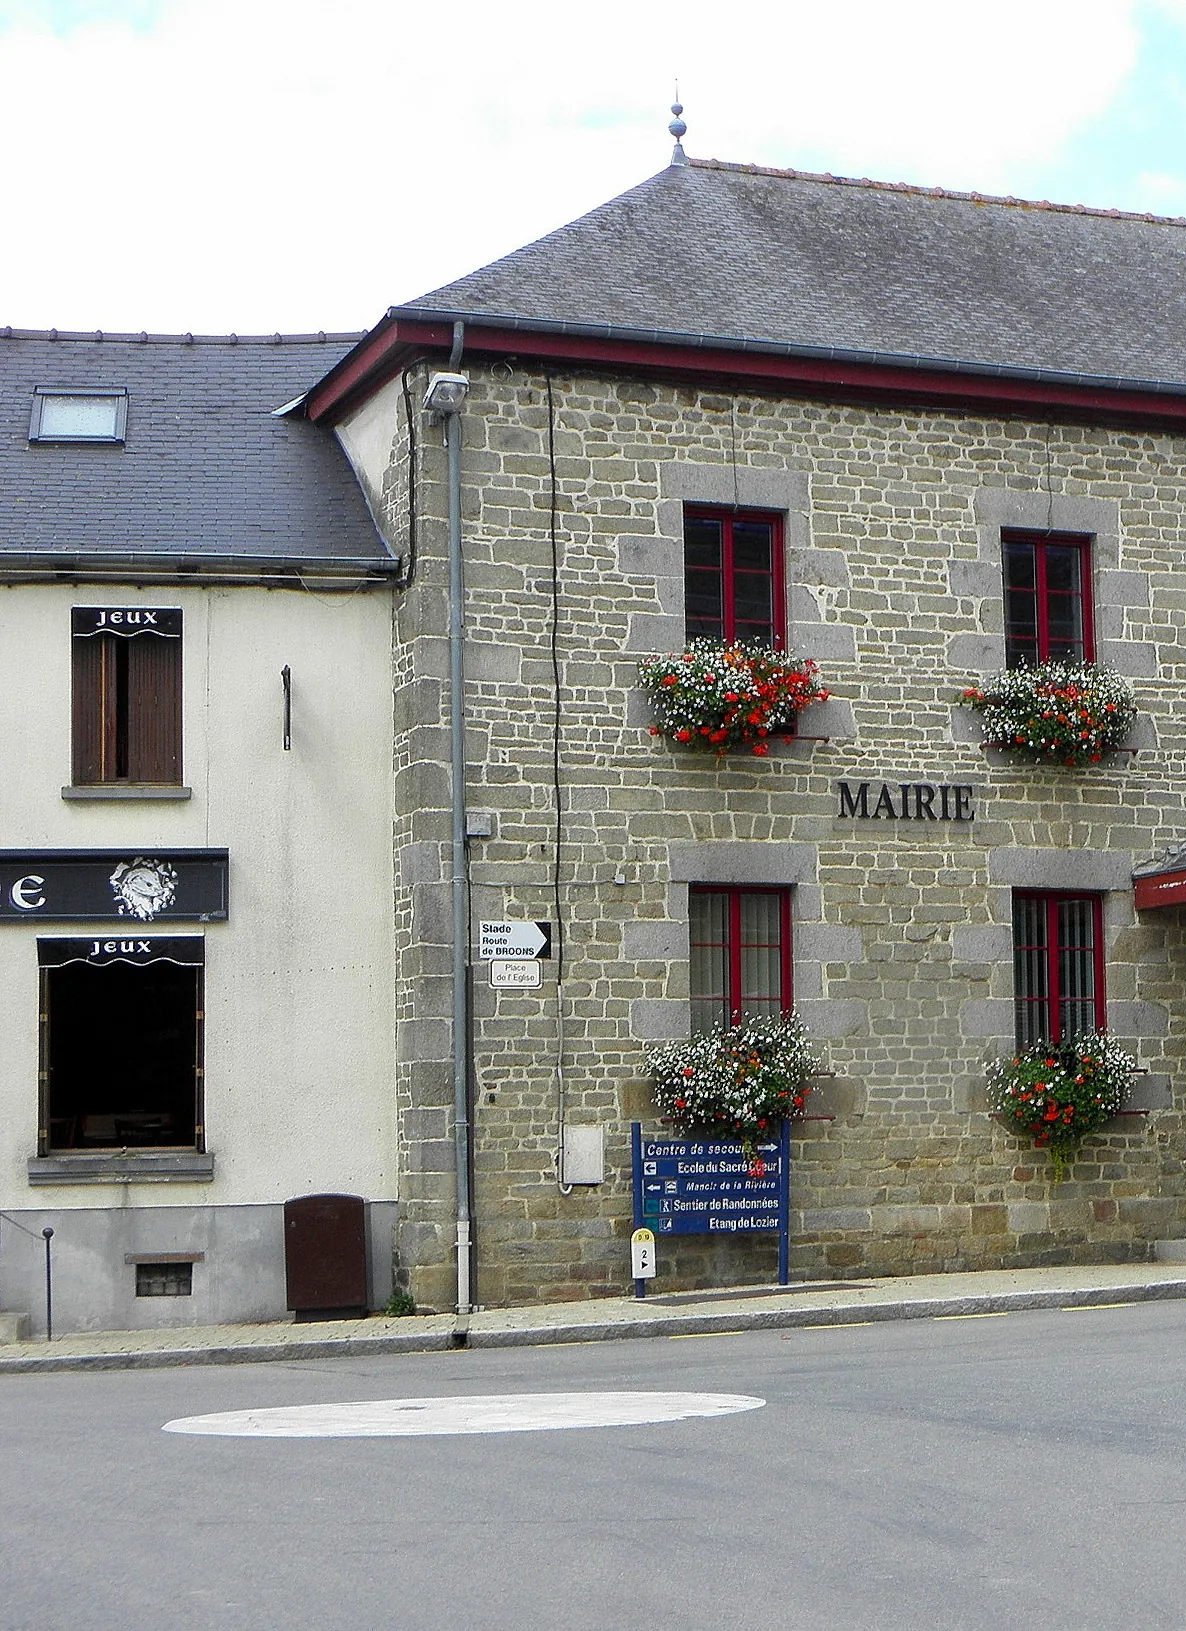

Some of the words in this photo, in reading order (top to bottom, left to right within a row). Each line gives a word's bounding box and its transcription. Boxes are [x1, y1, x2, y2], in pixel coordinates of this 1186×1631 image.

[837, 782, 975, 821] MAIRIE
[482, 923, 512, 933] Stade
[482, 936, 508, 945] Route
[482, 947, 494, 955] de
[495, 947, 535, 956] BROONS
[505, 963, 527, 971] Place
[496, 973, 506, 981] de
[647, 1143, 686, 1156] Centre
[690, 1143, 703, 1155] de
[678, 1161, 705, 1174] Ecole
[705, 1161, 718, 1173] du
[719, 1160, 747, 1173] Sacré
[719, 1181, 731, 1190] de
[733, 1181, 742, 1190] la
[673, 1199, 709, 1212] Sentier
[709, 1199, 721, 1211] de
[722, 1197, 779, 1209] Randonnées
[709, 1217, 737, 1231] Etang
[737, 1216, 750, 1229] de
[750, 1215, 779, 1228] Lozier
[641, 1249, 648, 1259] 2
